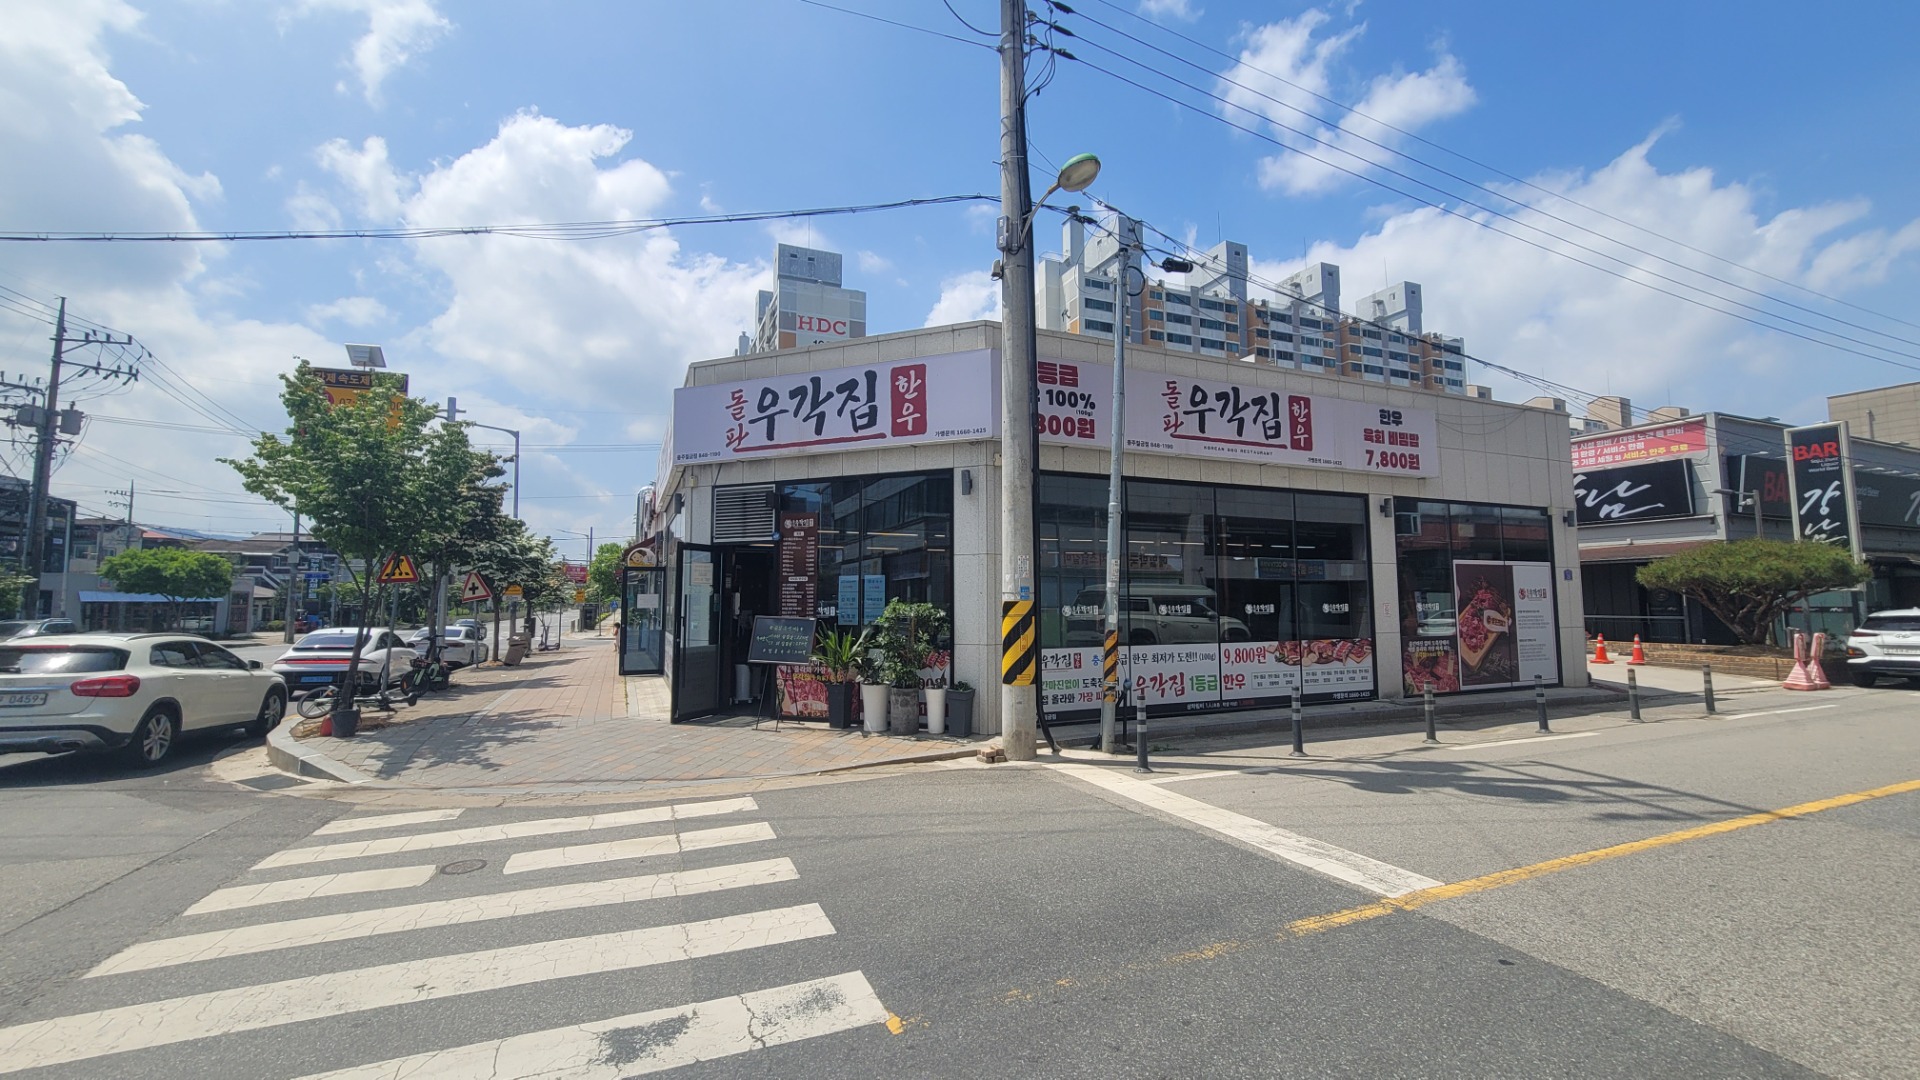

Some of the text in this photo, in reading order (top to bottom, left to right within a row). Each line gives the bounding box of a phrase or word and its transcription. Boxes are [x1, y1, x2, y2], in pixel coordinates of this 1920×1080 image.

[798, 315, 846, 335] HDC
[338, 374, 372, 386] 속도제
[1038, 361, 1078, 388] 등급
[748, 370, 878, 441] 우각집
[895, 370, 921, 432] 한우
[1046, 389, 1096, 410] 100%
[1183, 384, 1282, 440] 우각집
[1379, 409, 1403, 426] 한우
[1291, 401, 1309, 447] 한우
[1364, 428, 1419, 447] 육회 비빔밥
[1365, 449, 1420, 470] 7,800원
[1794, 442, 1838, 461] BAR
[1092, 655, 1104, 666] 충
[1133, 652, 1149, 664] 한우
[1151, 652, 1175, 664] 최저가
[1177, 651, 1198, 662] 도전!!
[1223, 646, 1267, 666] 9,800원
[1133, 672, 1186, 698] 우각집
[1189, 674, 1218, 692] 1등급
[1223, 673, 1246, 690] 한우
[9, 694, 39, 704] 0459
[1078, 692, 1094, 703] 가장
